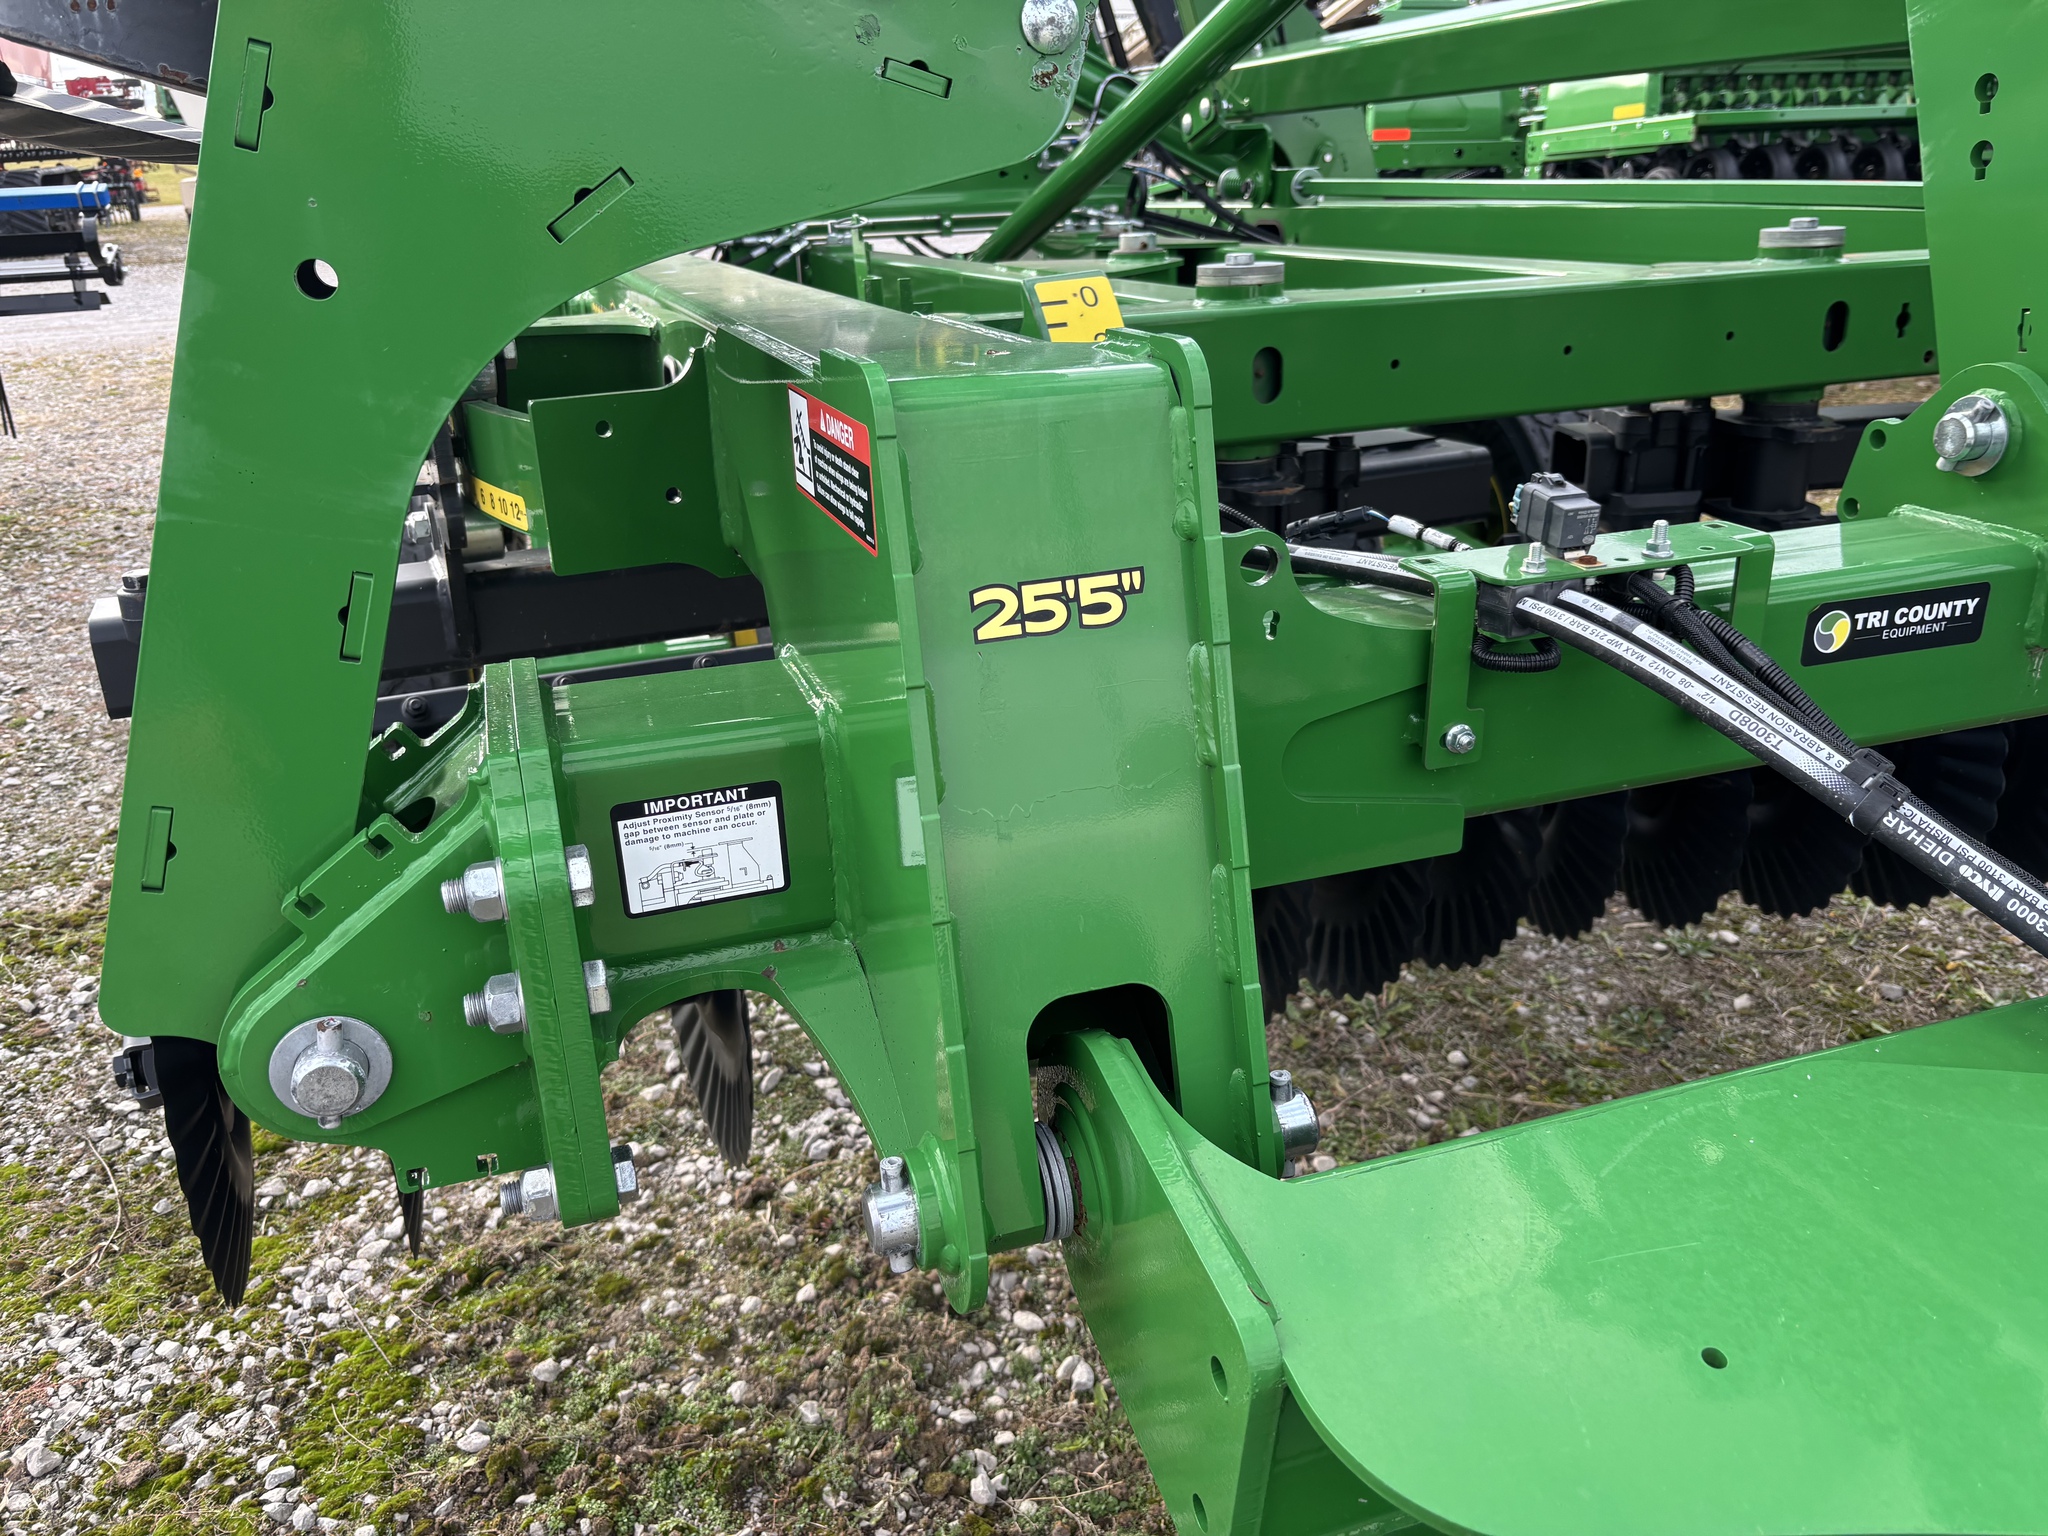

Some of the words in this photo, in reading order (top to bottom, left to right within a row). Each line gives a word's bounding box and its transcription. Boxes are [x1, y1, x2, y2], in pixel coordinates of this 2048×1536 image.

[825, 412, 854, 451] DANGER
[480, 488, 486, 505] 6
[490, 493, 496, 510] 8
[498, 496, 508, 516] 10
[1356, 558, 1399, 571] RESISTANT
[970, 567, 1144, 644] 25'5"
[1528, 601, 1543, 612] PSI
[1544, 607, 1566, 621] 3100
[1854, 610, 1889, 630] TRI
[1894, 597, 1981, 625] COUNTY
[1569, 617, 1589, 632] BAR
[1589, 628, 1608, 641] 215
[1882, 621, 1947, 640] EQUIPMENT
[1606, 637, 1624, 650] WP
[1623, 645, 1647, 662] MAX
[1648, 659, 1676, 680] DN12
[1678, 677, 1694, 689] -08
[1710, 673, 1769, 715] RESISTANT
[1696, 691, 1717, 706] 1/2"
[1729, 709, 1784, 752] T3008D
[1767, 711, 1826, 753] ABRASION
[643, 787, 748, 815] IMPORTANT
[623, 819, 650, 830] Adjust
[652, 813, 693, 825] Proximity
[695, 808, 724, 818] Sensor
[745, 800, 772, 811] (8mm)
[1900, 804, 1918, 823] IC-
[623, 830, 640, 840] gap
[643, 824, 680, 835] between
[682, 818, 712, 829] sensor
[715, 814, 731, 823] and
[733, 811, 754, 821] plate
[625, 836, 660, 846] damage
[674, 826, 710, 838] machine
[713, 824, 729, 832] can
[731, 820, 758, 829] occur.
[1918, 816, 1953, 845] MSHA
[1956, 844, 1978, 864] PSI
[1978, 860, 2007, 882] 3100
[1959, 864, 2006, 902] RYCO
[2014, 883, 2041, 905] BAR
